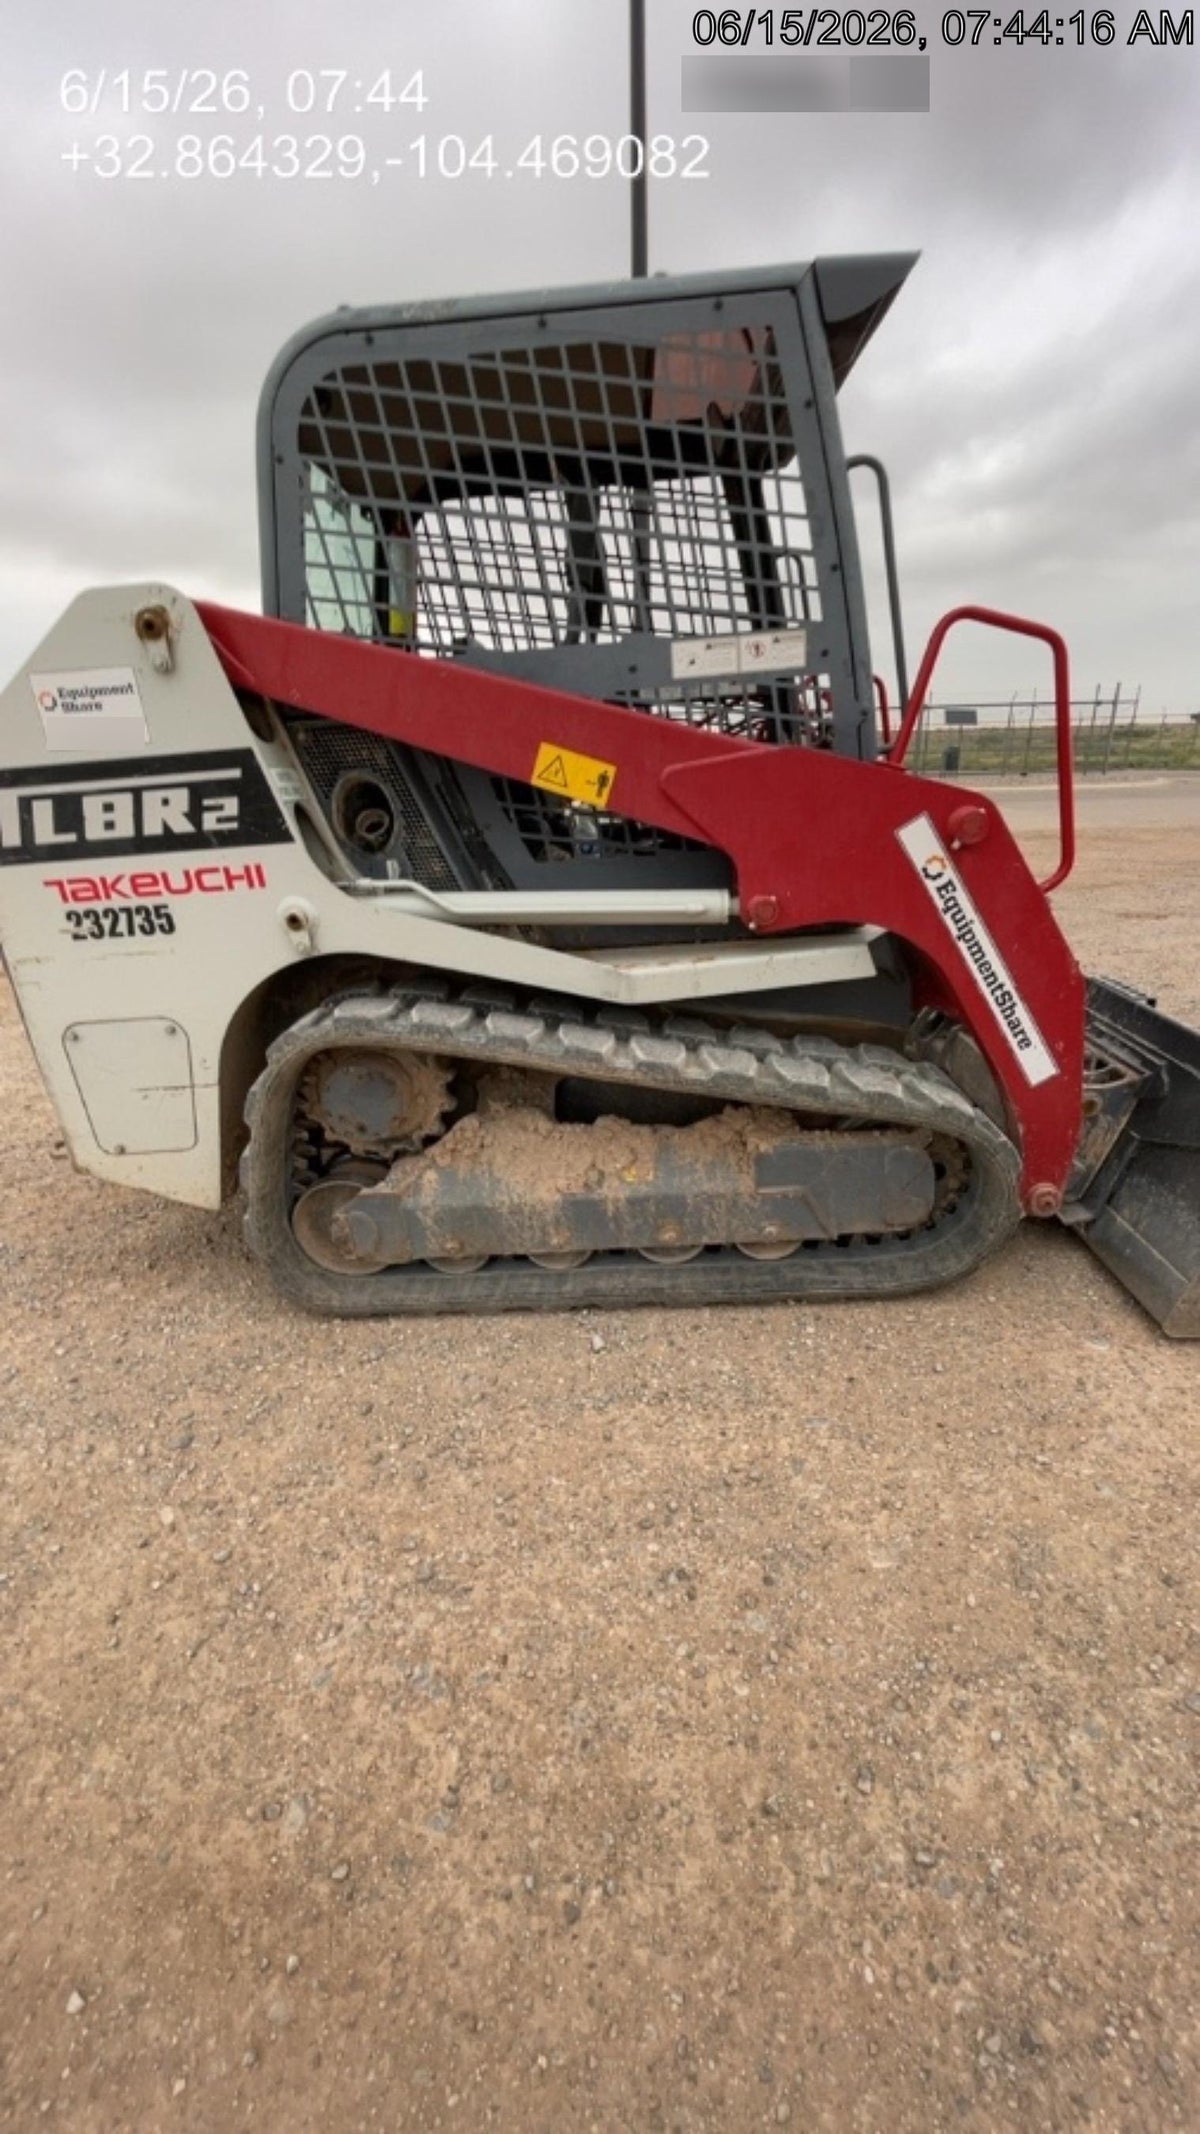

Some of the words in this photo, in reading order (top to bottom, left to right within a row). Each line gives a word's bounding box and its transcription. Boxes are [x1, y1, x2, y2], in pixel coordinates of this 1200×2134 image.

[57, 682, 135, 700] Equipment
[61, 701, 103, 714] Share
[65, 904, 176, 941] 232735
[935, 879, 1033, 1051] EquipmentShare
